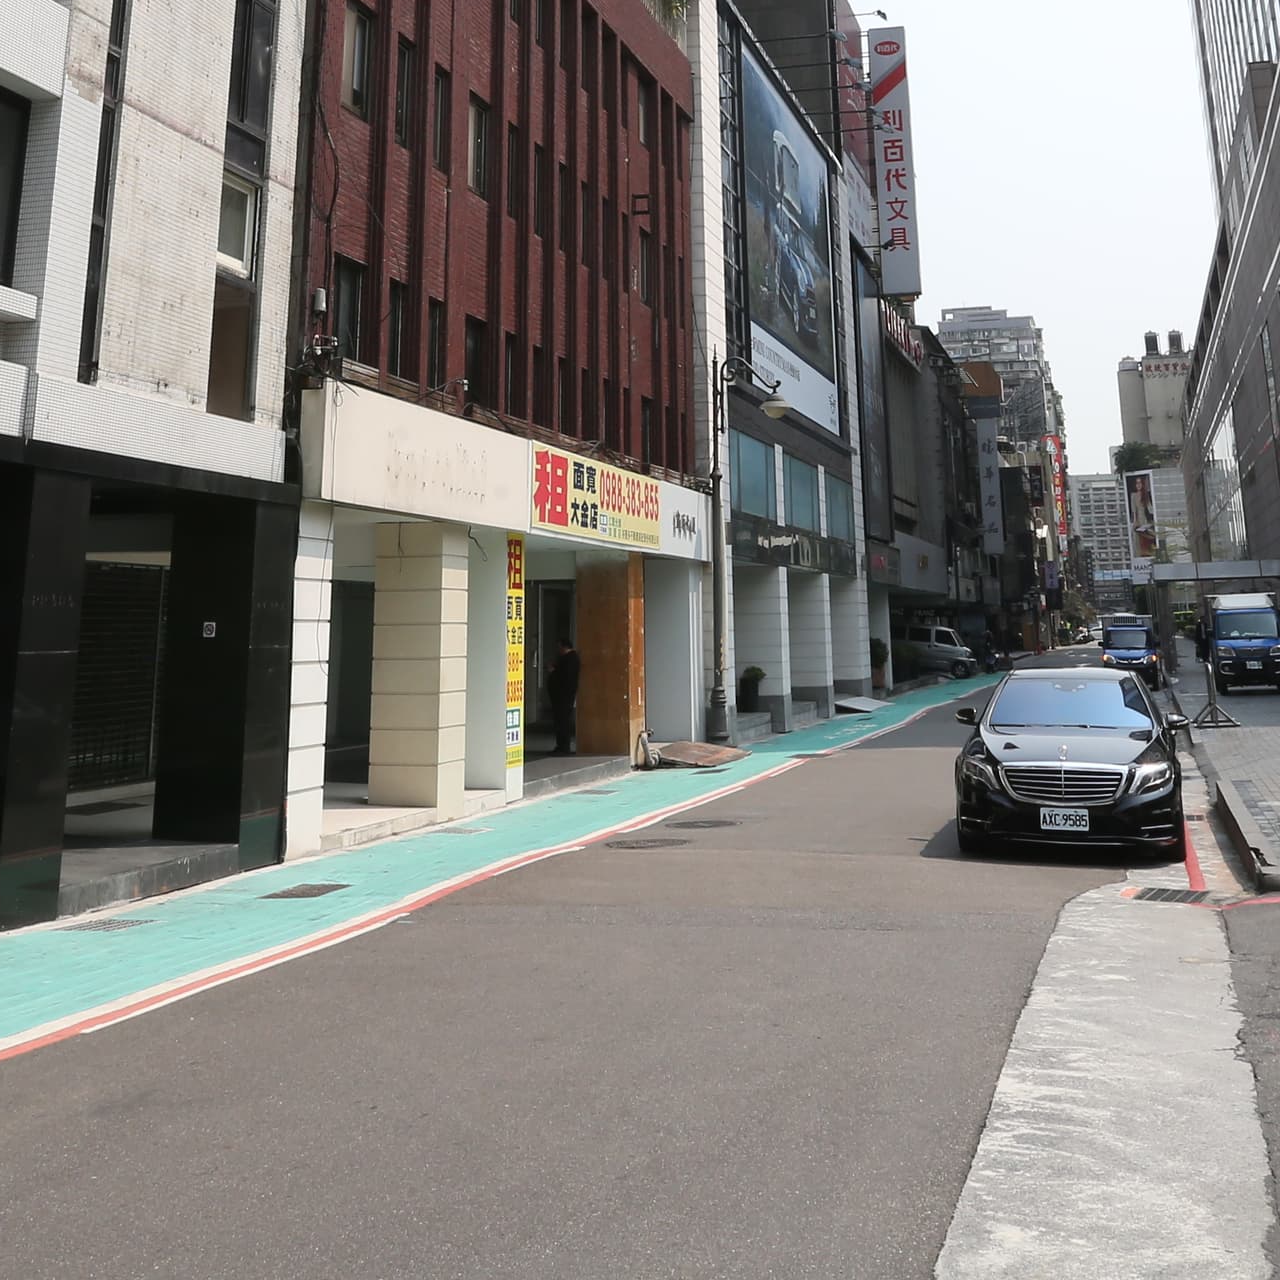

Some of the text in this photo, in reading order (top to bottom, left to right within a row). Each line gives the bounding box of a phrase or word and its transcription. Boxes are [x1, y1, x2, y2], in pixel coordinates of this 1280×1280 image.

[881, 109, 911, 252] 利百代文具
[533, 450, 569, 527] 租
[573, 461, 597, 494] 面寬
[600, 469, 659, 522] 0988-383-855
[570, 497, 599, 530] 大金店
